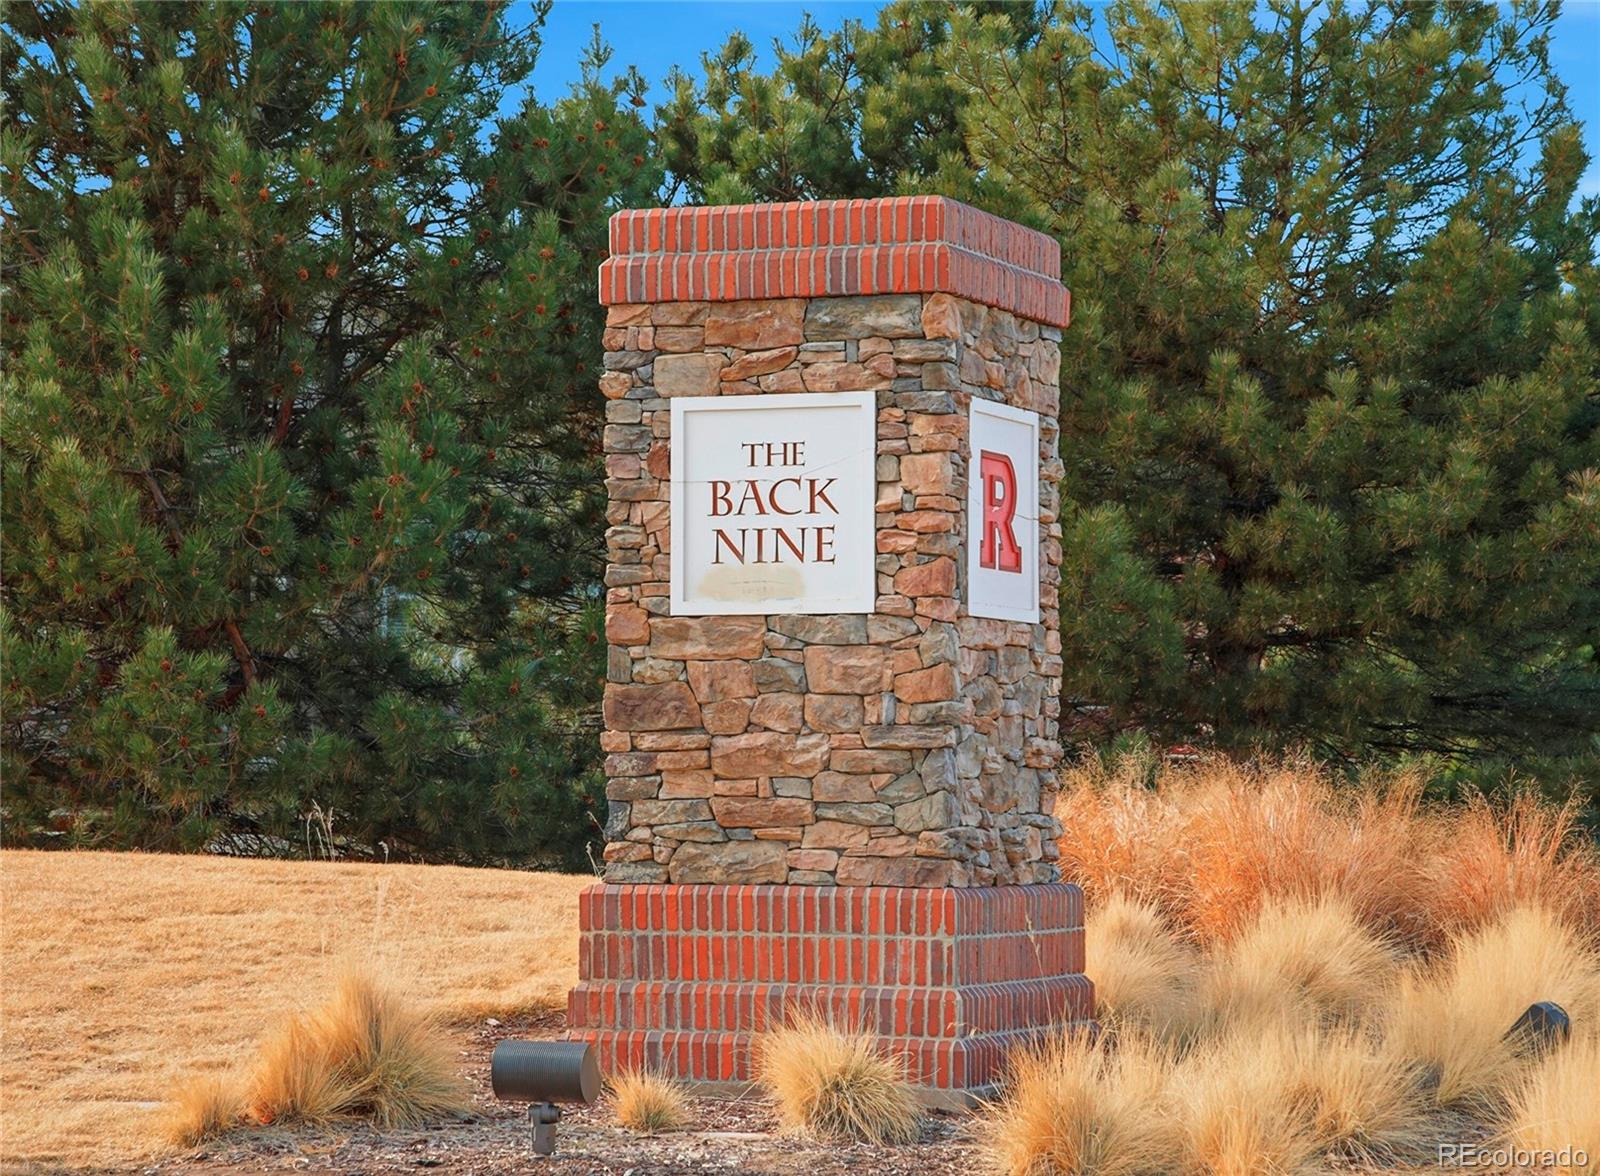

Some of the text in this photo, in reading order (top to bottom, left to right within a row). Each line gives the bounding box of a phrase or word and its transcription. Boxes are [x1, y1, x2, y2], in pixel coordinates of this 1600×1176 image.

[741, 441, 806, 467] THE
[706, 475, 840, 517] BACK
[979, 449, 1022, 574] R
[711, 525, 836, 566] NINE
